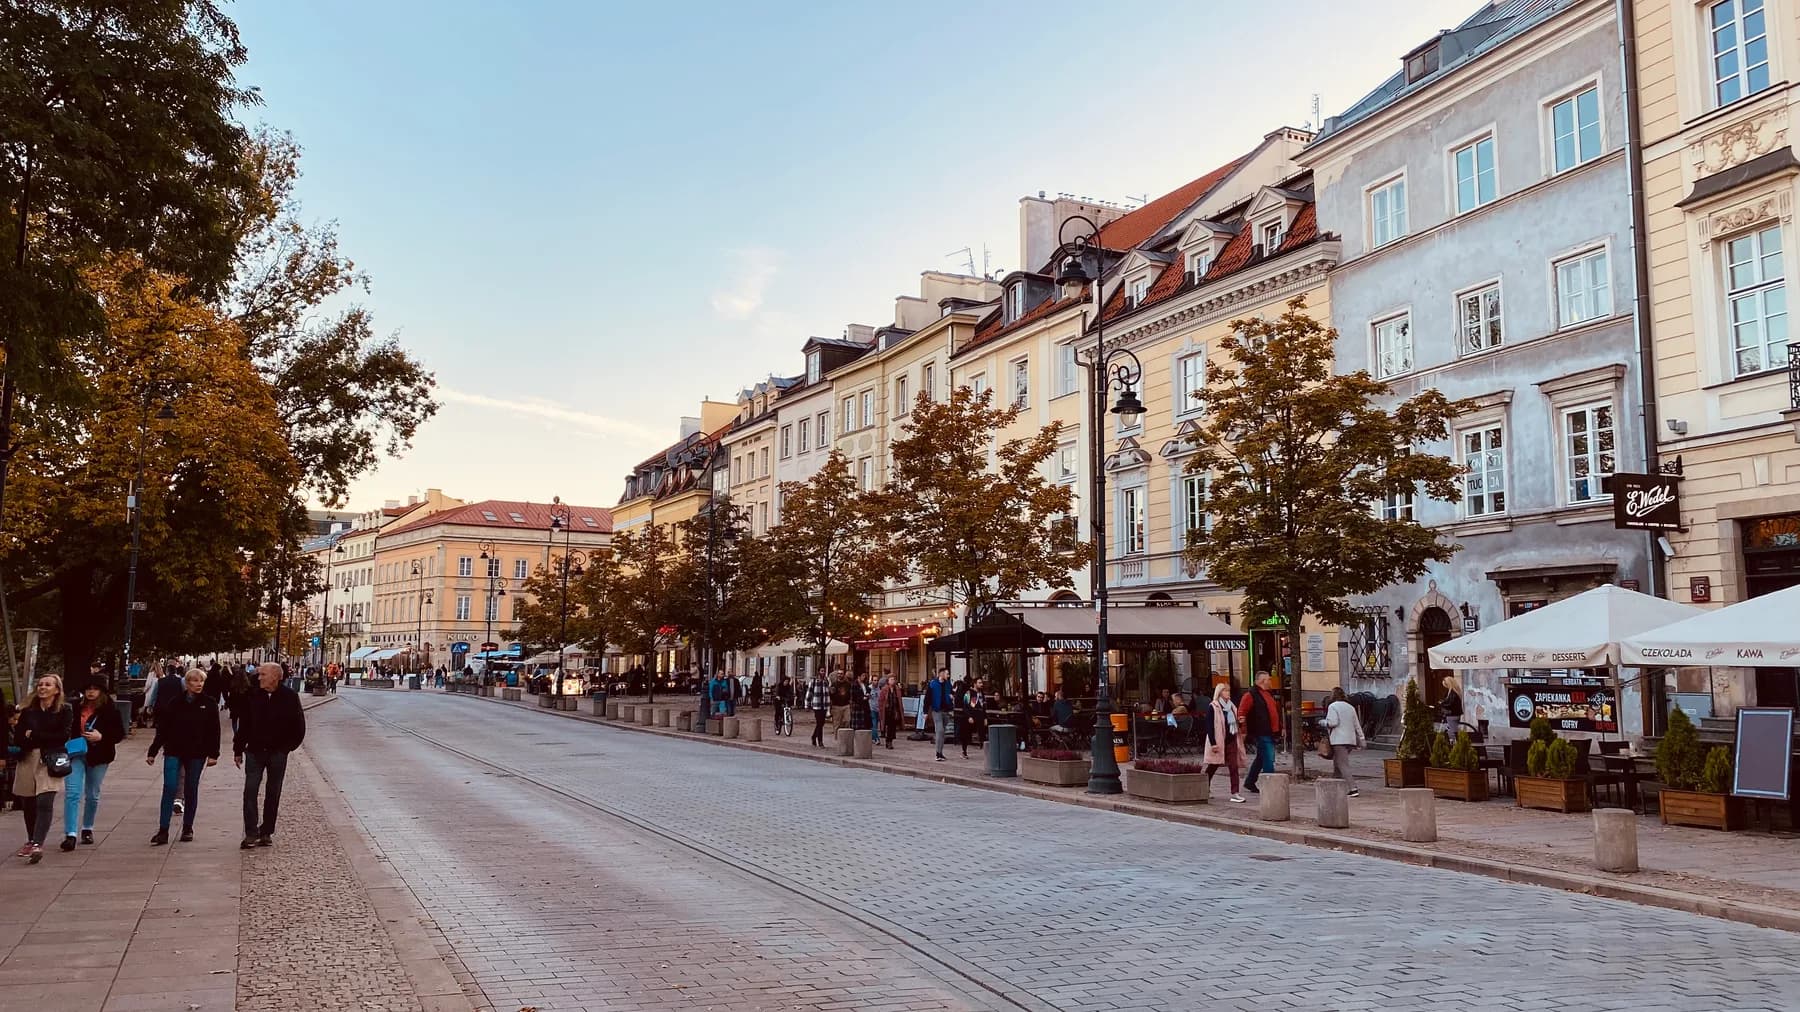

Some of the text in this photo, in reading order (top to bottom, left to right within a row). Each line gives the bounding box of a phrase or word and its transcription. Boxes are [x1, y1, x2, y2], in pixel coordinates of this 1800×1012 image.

[1693, 584, 1705, 597] 45
[447, 633, 479, 641] KINO
[1048, 639, 1093, 650] GUINNESS
[1204, 639, 1247, 650] GUINNESS
[1443, 655, 1478, 664] CHOCOLATE
[1501, 653, 1527, 662] COFFEE
[1552, 652, 1586, 662] DESSERTS
[1641, 648, 1693, 658] CZEKOLADA
[1737, 649, 1764, 659] KAWA
[1535, 692, 1571, 703] ZAPIEKANKA
[1561, 720, 1578, 729] GOFRY
